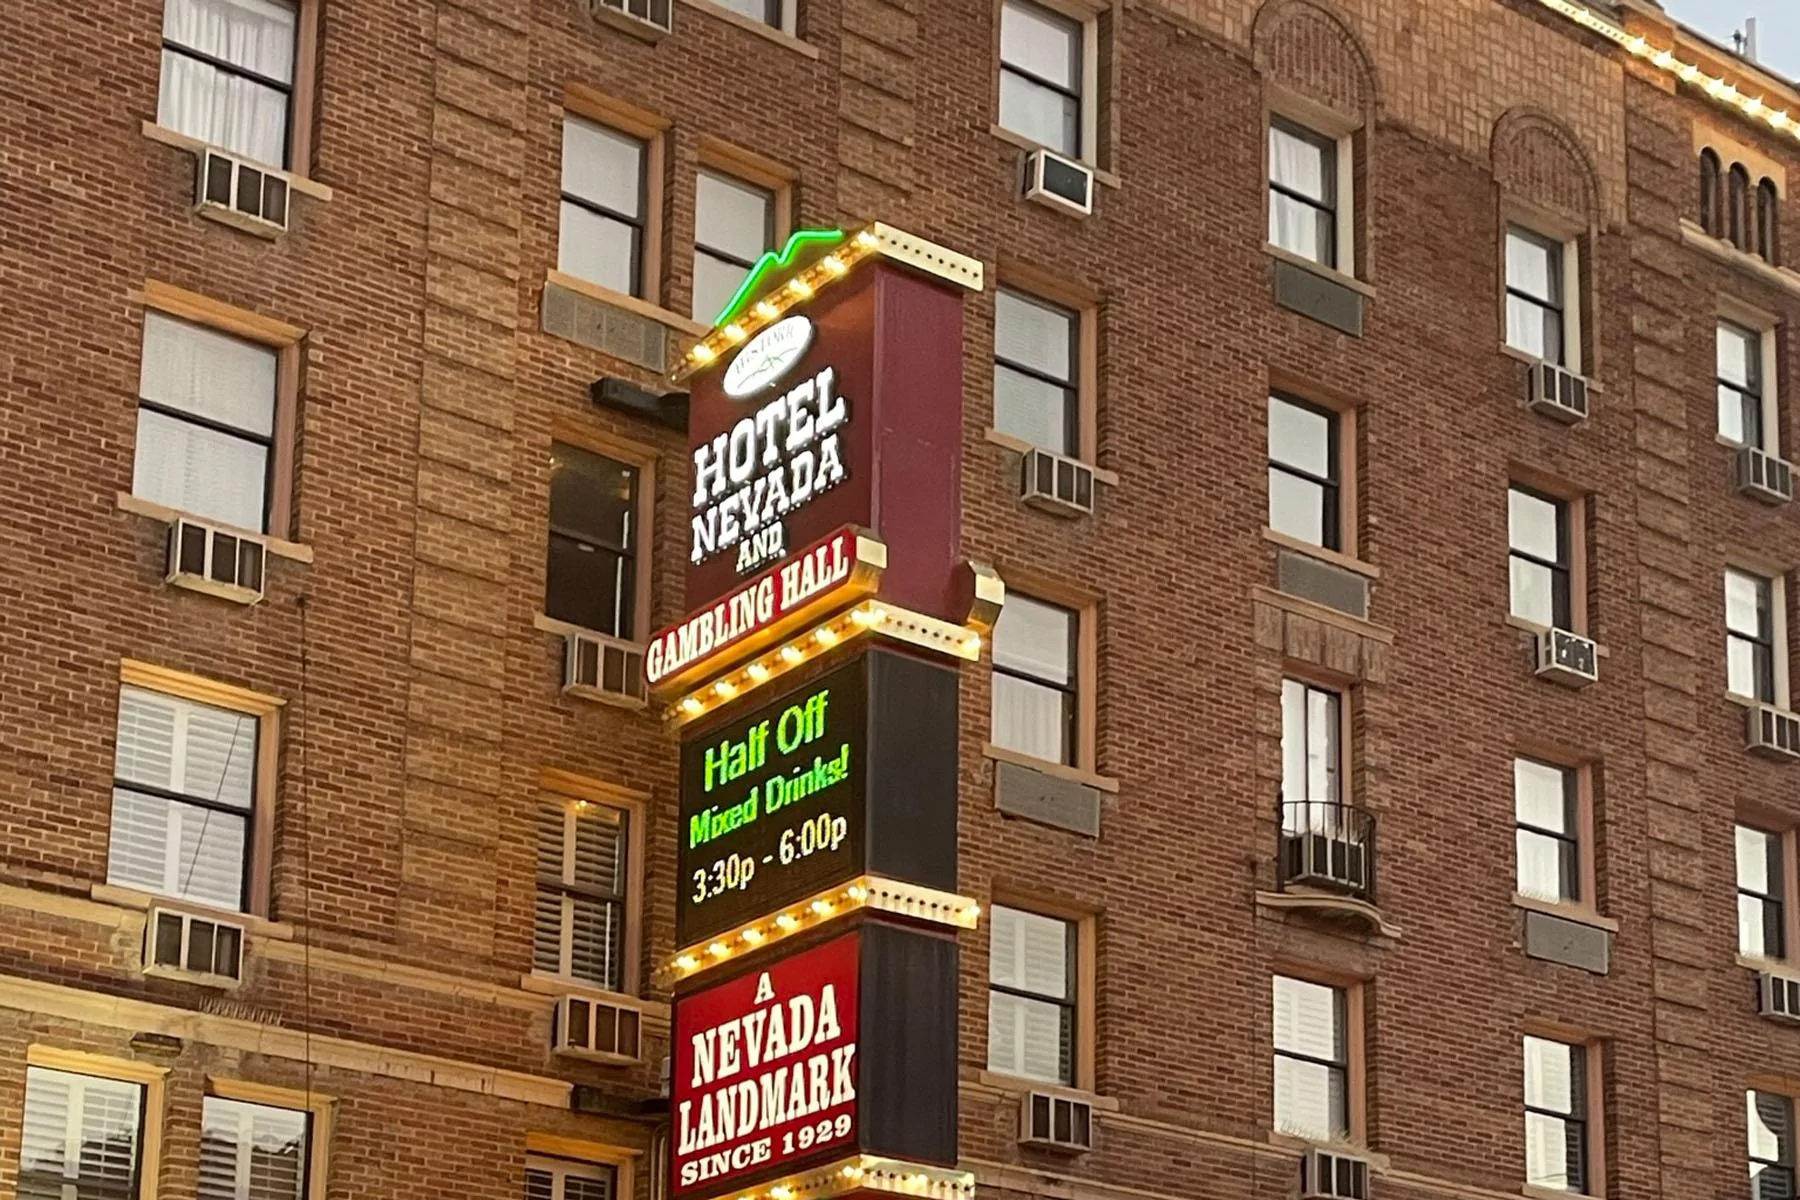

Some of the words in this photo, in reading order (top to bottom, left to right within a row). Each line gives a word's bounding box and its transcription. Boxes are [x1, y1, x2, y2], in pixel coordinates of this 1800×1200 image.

[693, 366, 847, 507] HOTEL
[691, 434, 845, 563] NEVADA
[736, 520, 784, 571] AND
[647, 572, 775, 684] GAMBLING
[780, 536, 849, 611] HALL
[704, 720, 769, 792] Half
[777, 690, 829, 755] Off
[690, 786, 758, 849] Mixed
[766, 744, 849, 814] Drinks!
[692, 854, 754, 903] 3:30p
[779, 813, 847, 865] 6:00p
[691, 984, 840, 1088] NEVADA
[754, 972, 775, 1004] A
[678, 1043, 856, 1156] LANDMARK
[681, 1137, 771, 1186] SINCE
[782, 1114, 852, 1155] 1929
